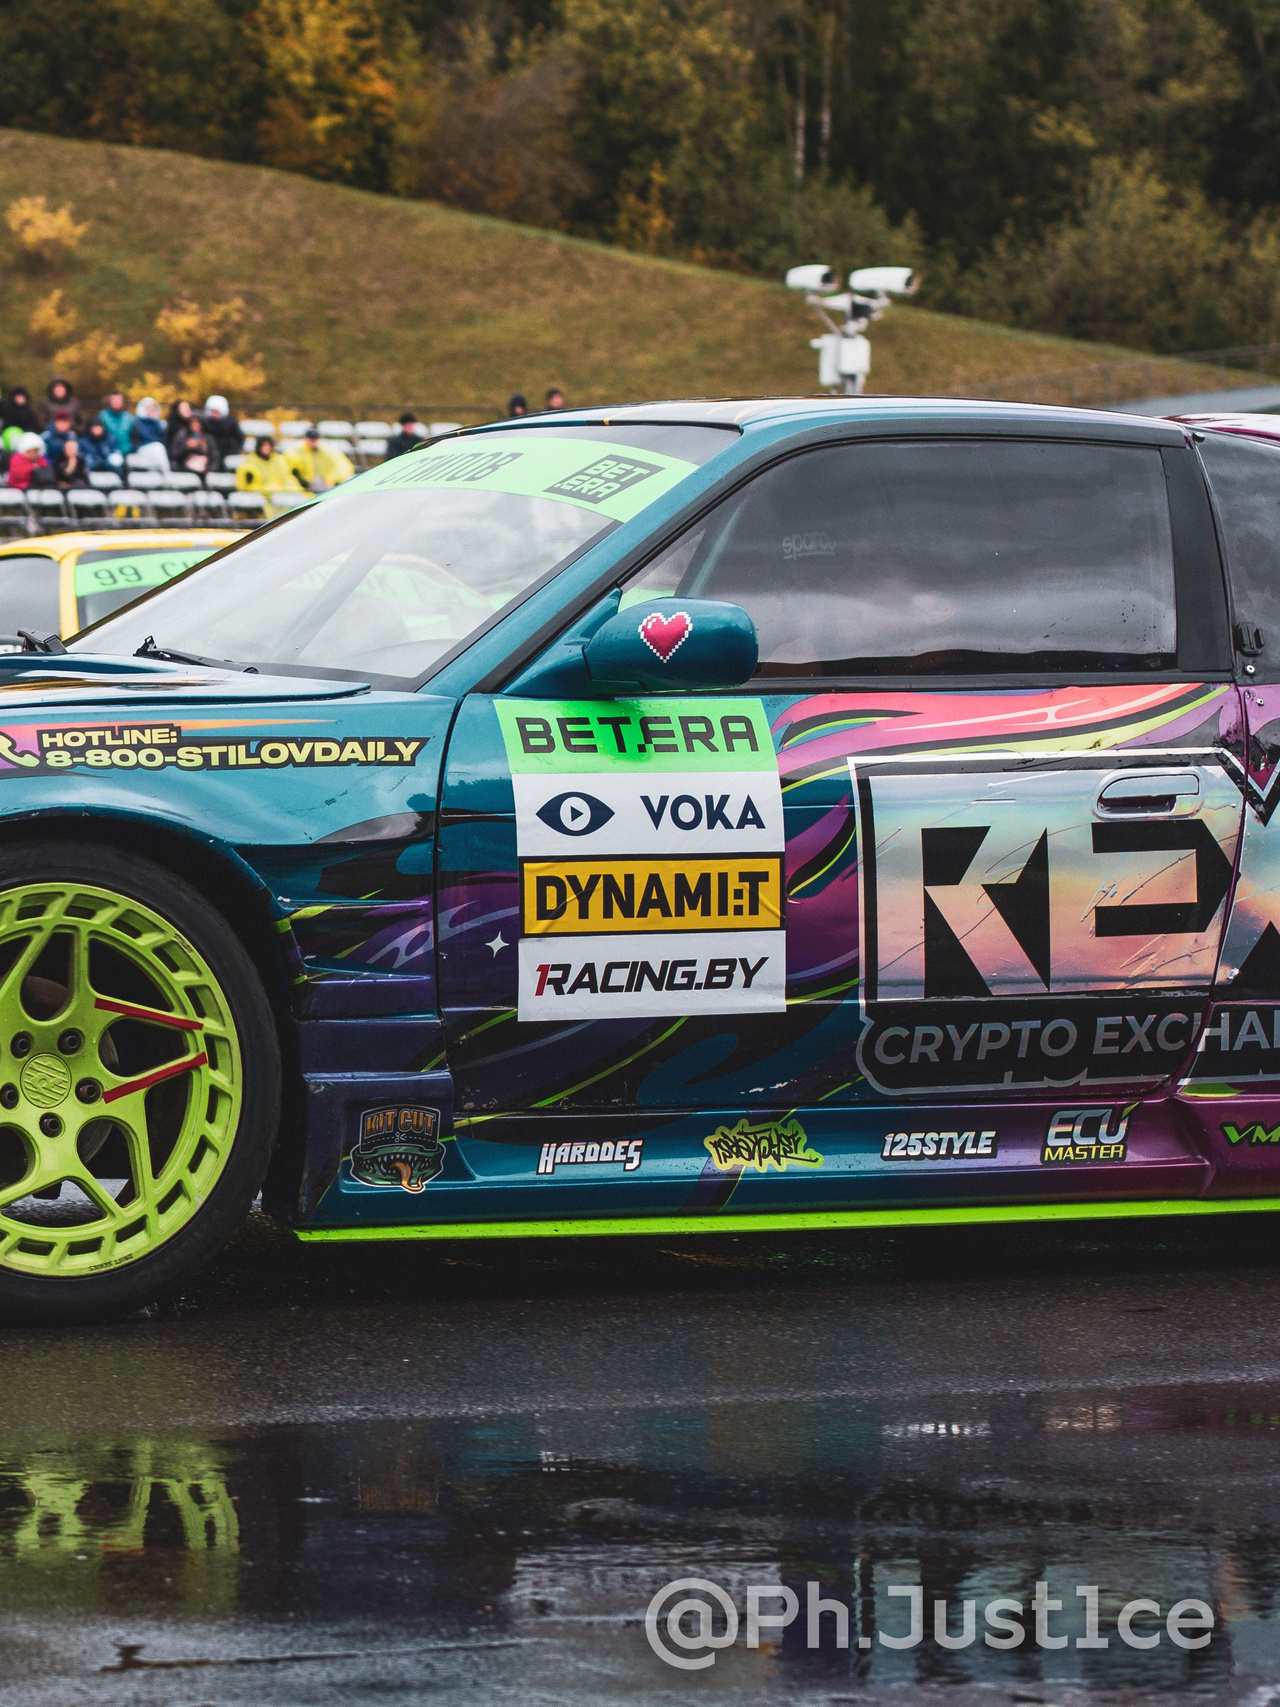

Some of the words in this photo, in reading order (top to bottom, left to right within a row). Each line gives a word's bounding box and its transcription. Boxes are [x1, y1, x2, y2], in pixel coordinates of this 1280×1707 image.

[374, 451, 524, 486] СТИЛОВ
[584, 459, 651, 483] BET
[94, 564, 142, 586] 99
[41, 728, 178, 748] HOTLINE:
[45, 741, 421, 768] 8-800-STILOVDAILY
[639, 793, 767, 831] VOKA
[534, 956, 770, 997] 1RACING.BY
[874, 1018, 1078, 1065] CRYPTO
[1092, 1009, 1280, 1056] EXCHA
[365, 1110, 395, 1137] KIT
[400, 1109, 436, 1136] CUT
[1047, 1103, 1138, 1148] ECU
[883, 1131, 997, 1157] 125STYLE
[1044, 1144, 1125, 1162] MASTER
